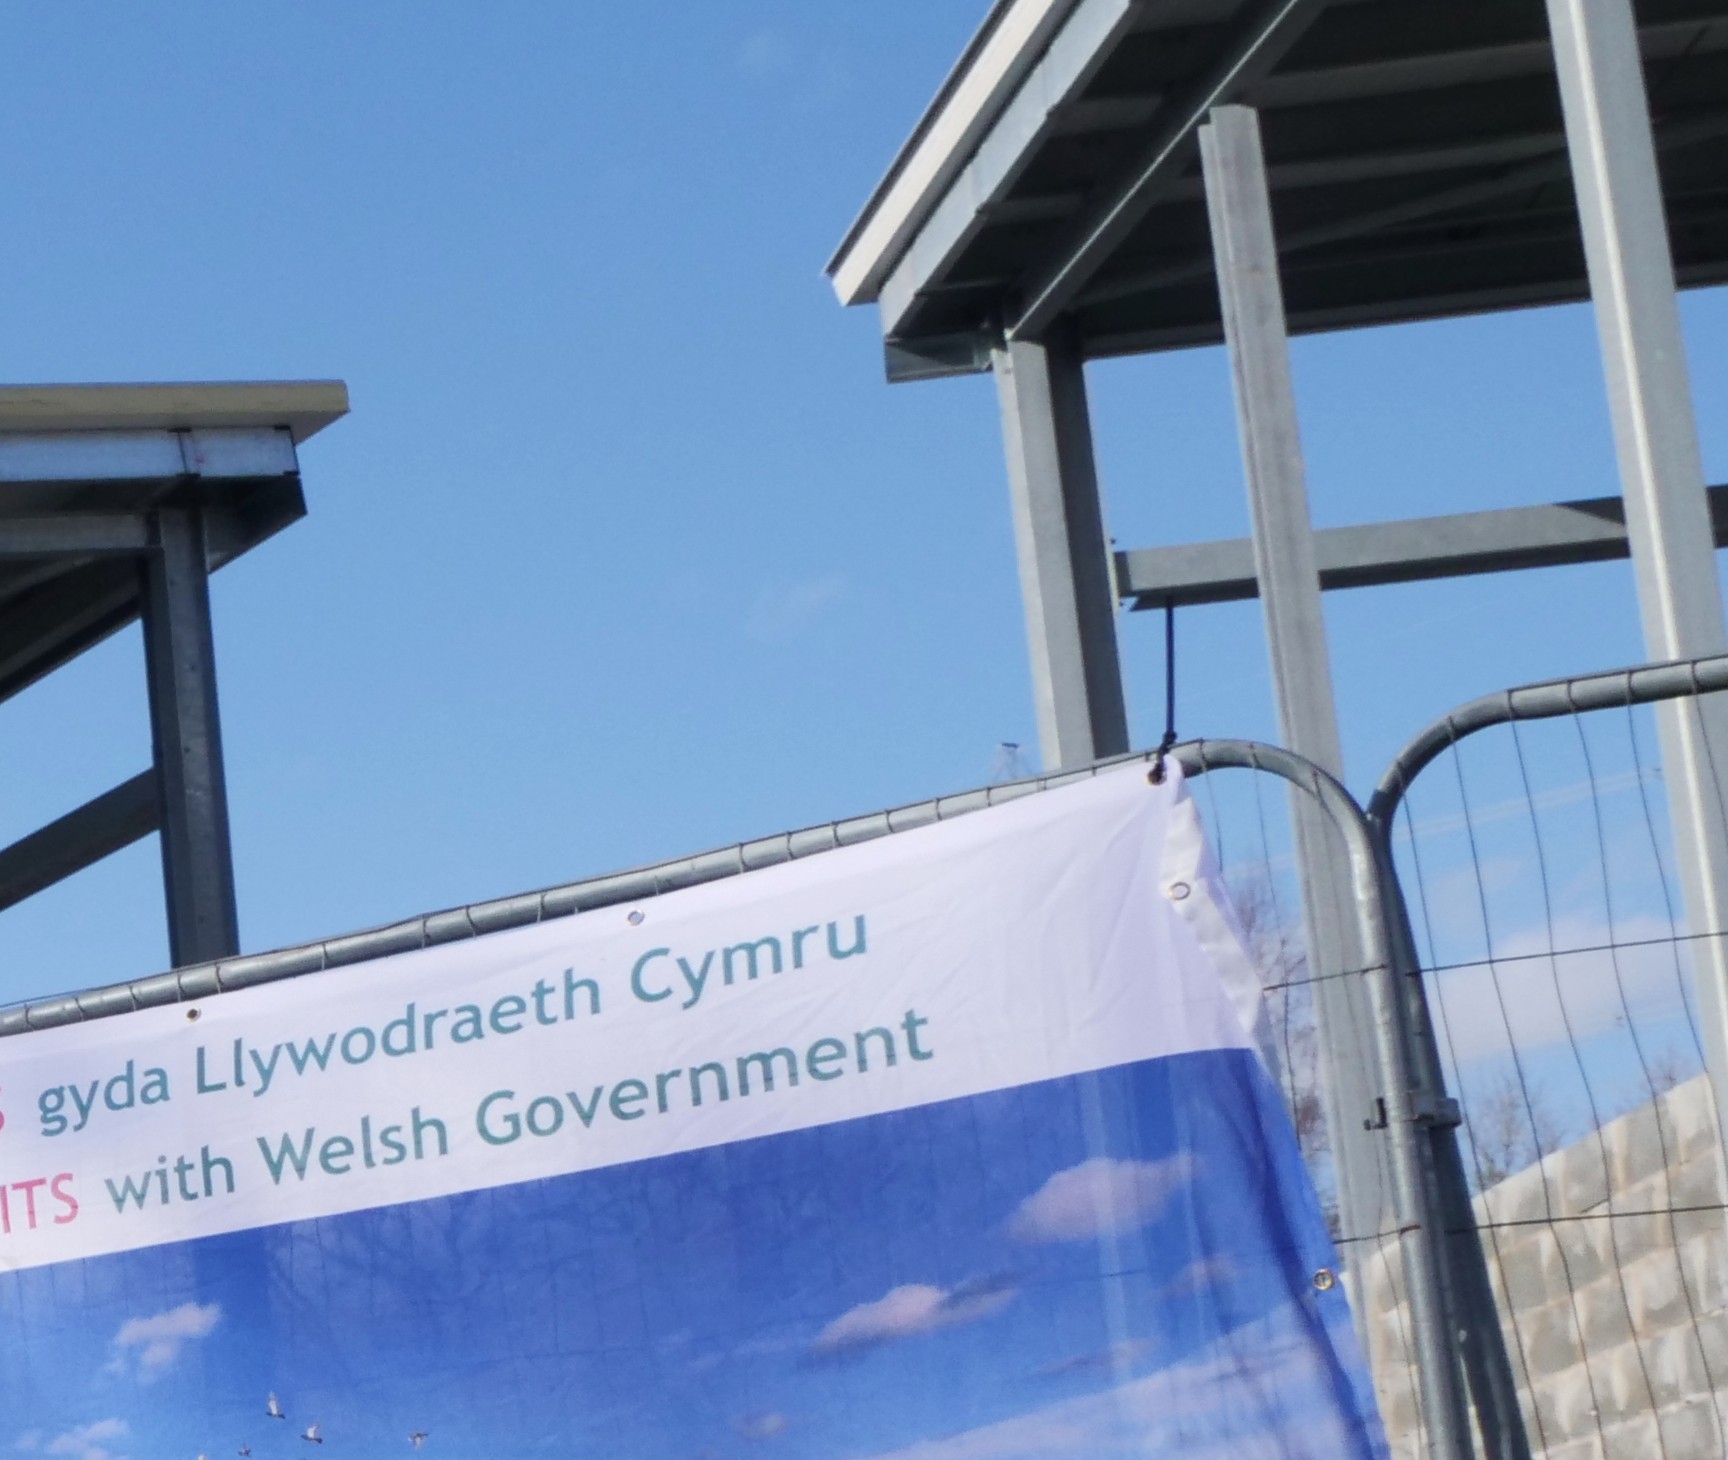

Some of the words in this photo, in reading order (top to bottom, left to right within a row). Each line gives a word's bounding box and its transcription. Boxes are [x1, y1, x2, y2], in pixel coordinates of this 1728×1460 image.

[37, 1059, 171, 1137] gyda
[194, 968, 600, 1098] Llywodraeth
[629, 915, 867, 1010] Cymru
[104, 1145, 235, 1213] with
[258, 1107, 448, 1185] Welsh
[476, 1009, 933, 1146] Government
